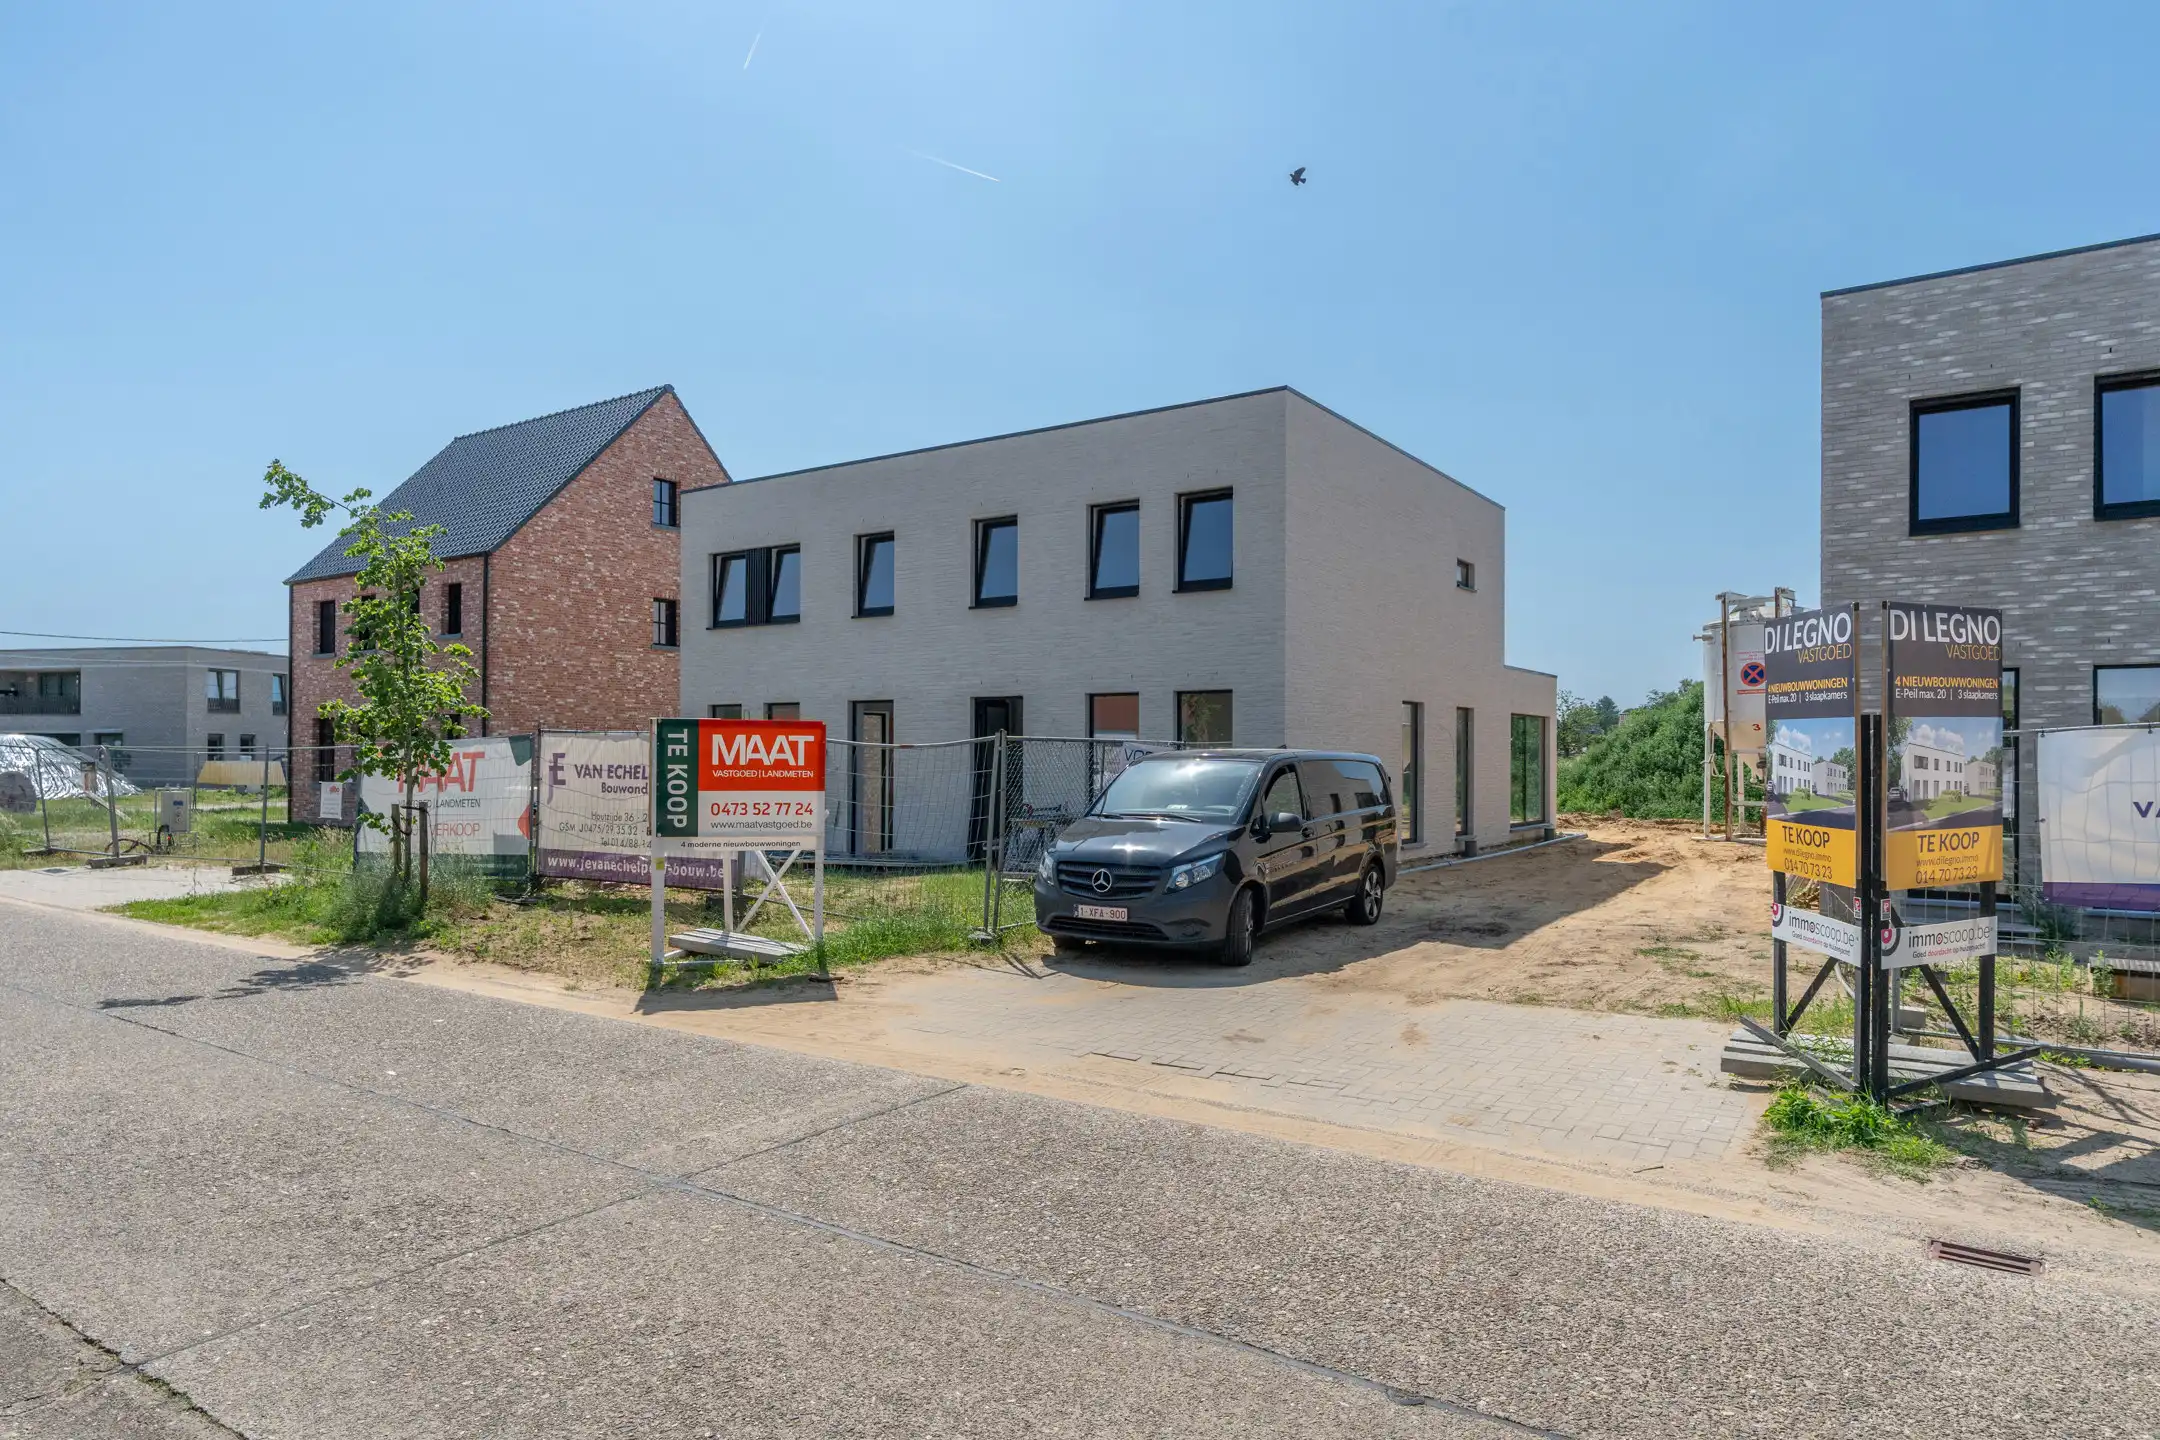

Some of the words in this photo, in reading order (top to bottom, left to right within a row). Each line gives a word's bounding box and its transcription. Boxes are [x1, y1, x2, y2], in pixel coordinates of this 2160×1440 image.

[1765, 626, 1780, 654] DI
[1784, 612, 1852, 651] LEGNO
[1890, 609, 1917, 641] DI
[1922, 611, 2000, 645] LEGNO
[1797, 643, 1852, 664] VASTGOED
[1945, 644, 2000, 661] VASTGOED
[1895, 676, 1901, 687] 4
[1902, 676, 1998, 689] NIEUWBOUWWONINGEN
[1790, 692, 1797, 702] 20
[1895, 689, 1918, 699] E-Peil
[1937, 689, 1947, 699] 20
[1958, 689, 1963, 699] 3
[1752, 723, 1761, 731] 3
[667, 728, 688, 757] TE
[711, 734, 815, 766] MAAT
[574, 764, 603, 779] VAN
[607, 764, 648, 780] ECHEL
[712, 769, 758, 779] VASTGOED
[762, 770, 814, 778] LANDMETEN
[666, 764, 688, 828] KOOP
[710, 802, 748, 816] 0473
[752, 803, 770, 816] 52
[775, 803, 791, 816] 77
[795, 803, 813, 816] 24
[710, 820, 812, 832] www.maatvastgoed.be
[687, 840, 721, 848] moderne
[723, 840, 801, 851] nieuwbouwwoningen
[1782, 826, 1794, 843] TE
[1796, 828, 1830, 848] KOOP
[1917, 834, 1936, 853] TE
[1939, 832, 1980, 851] KOOP
[1784, 857, 1798, 871] 014
[1799, 860, 1809, 875] 70
[1810, 862, 1820, 877] 73
[1821, 865, 1832, 879] 23
[1916, 869, 1935, 884] 014
[1939, 868, 1951, 882] 70
[1952, 867, 1964, 880] 73
[1965, 865, 1978, 880] 23
[1080, 907, 1126, 919] 1-XFA-900
[1788, 911, 1855, 947] immoscoop.be
[1908, 926, 1990, 948] immoscoop.be
